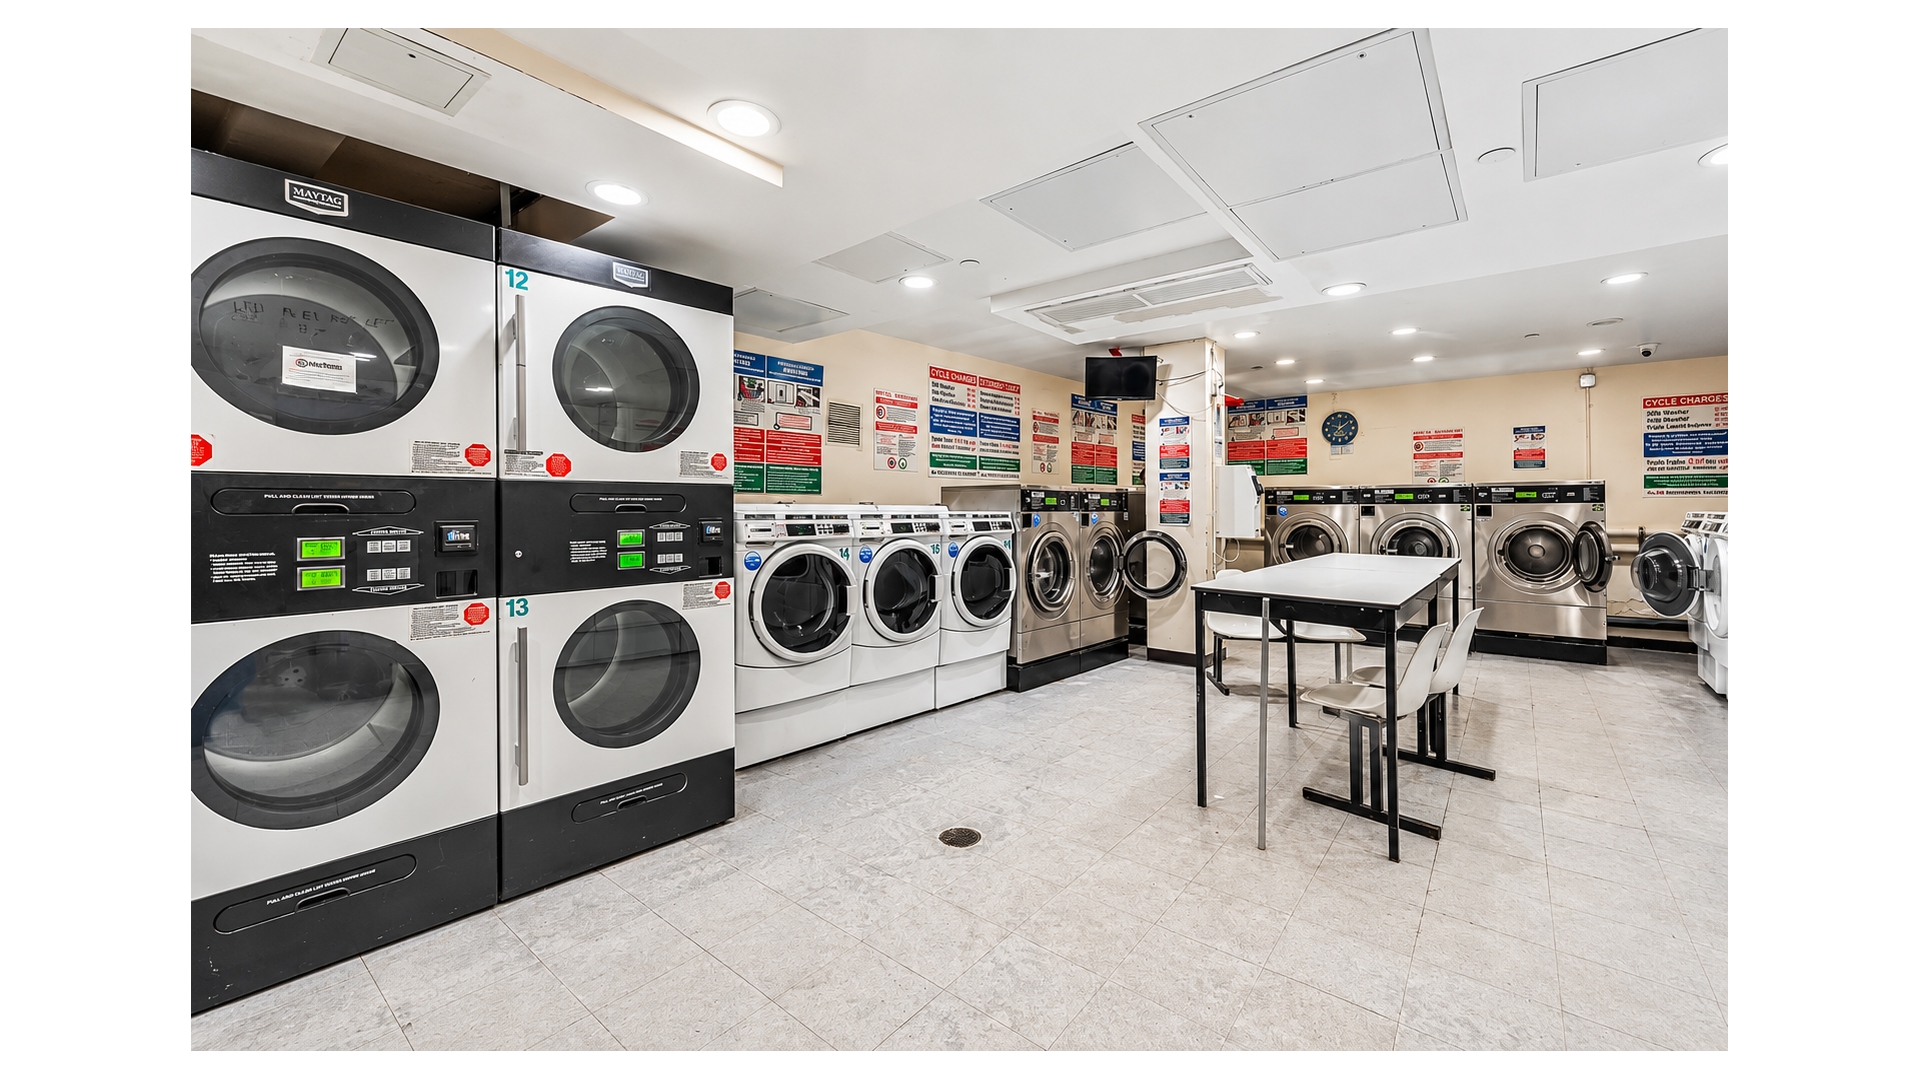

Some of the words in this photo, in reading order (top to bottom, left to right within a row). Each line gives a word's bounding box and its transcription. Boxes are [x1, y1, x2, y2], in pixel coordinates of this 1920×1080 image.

[293, 186, 342, 206] MAYTAG
[505, 269, 529, 291] 12
[931, 367, 950, 380] CYCLE
[1645, 397, 1677, 407] CYCLE
[505, 597, 529, 617] 13
